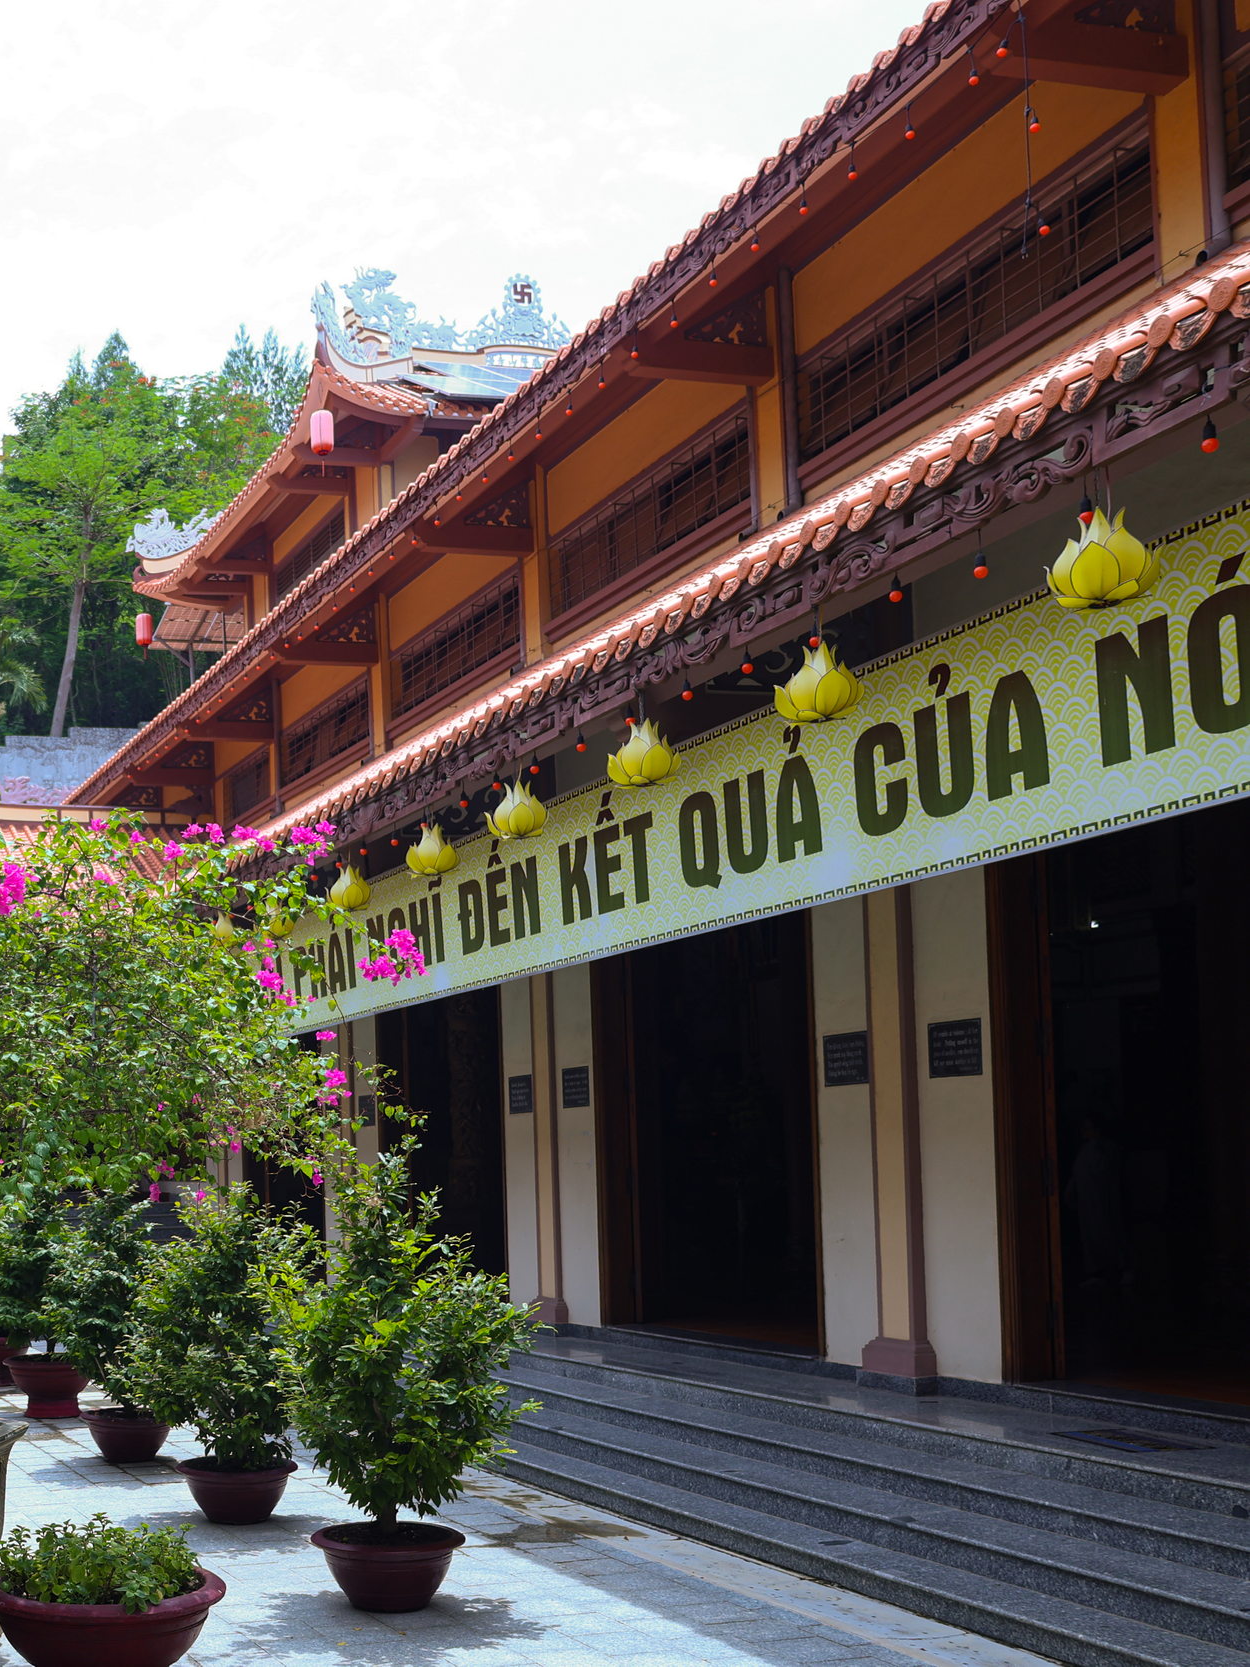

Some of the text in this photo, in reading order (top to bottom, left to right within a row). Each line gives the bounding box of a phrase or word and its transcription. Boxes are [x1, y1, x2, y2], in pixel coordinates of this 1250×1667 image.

[458, 839, 541, 955] ĐẾN
[558, 791, 653, 925] KẾT
[679, 725, 823, 889] QUẢ
[854, 663, 1050, 836] CỦA
